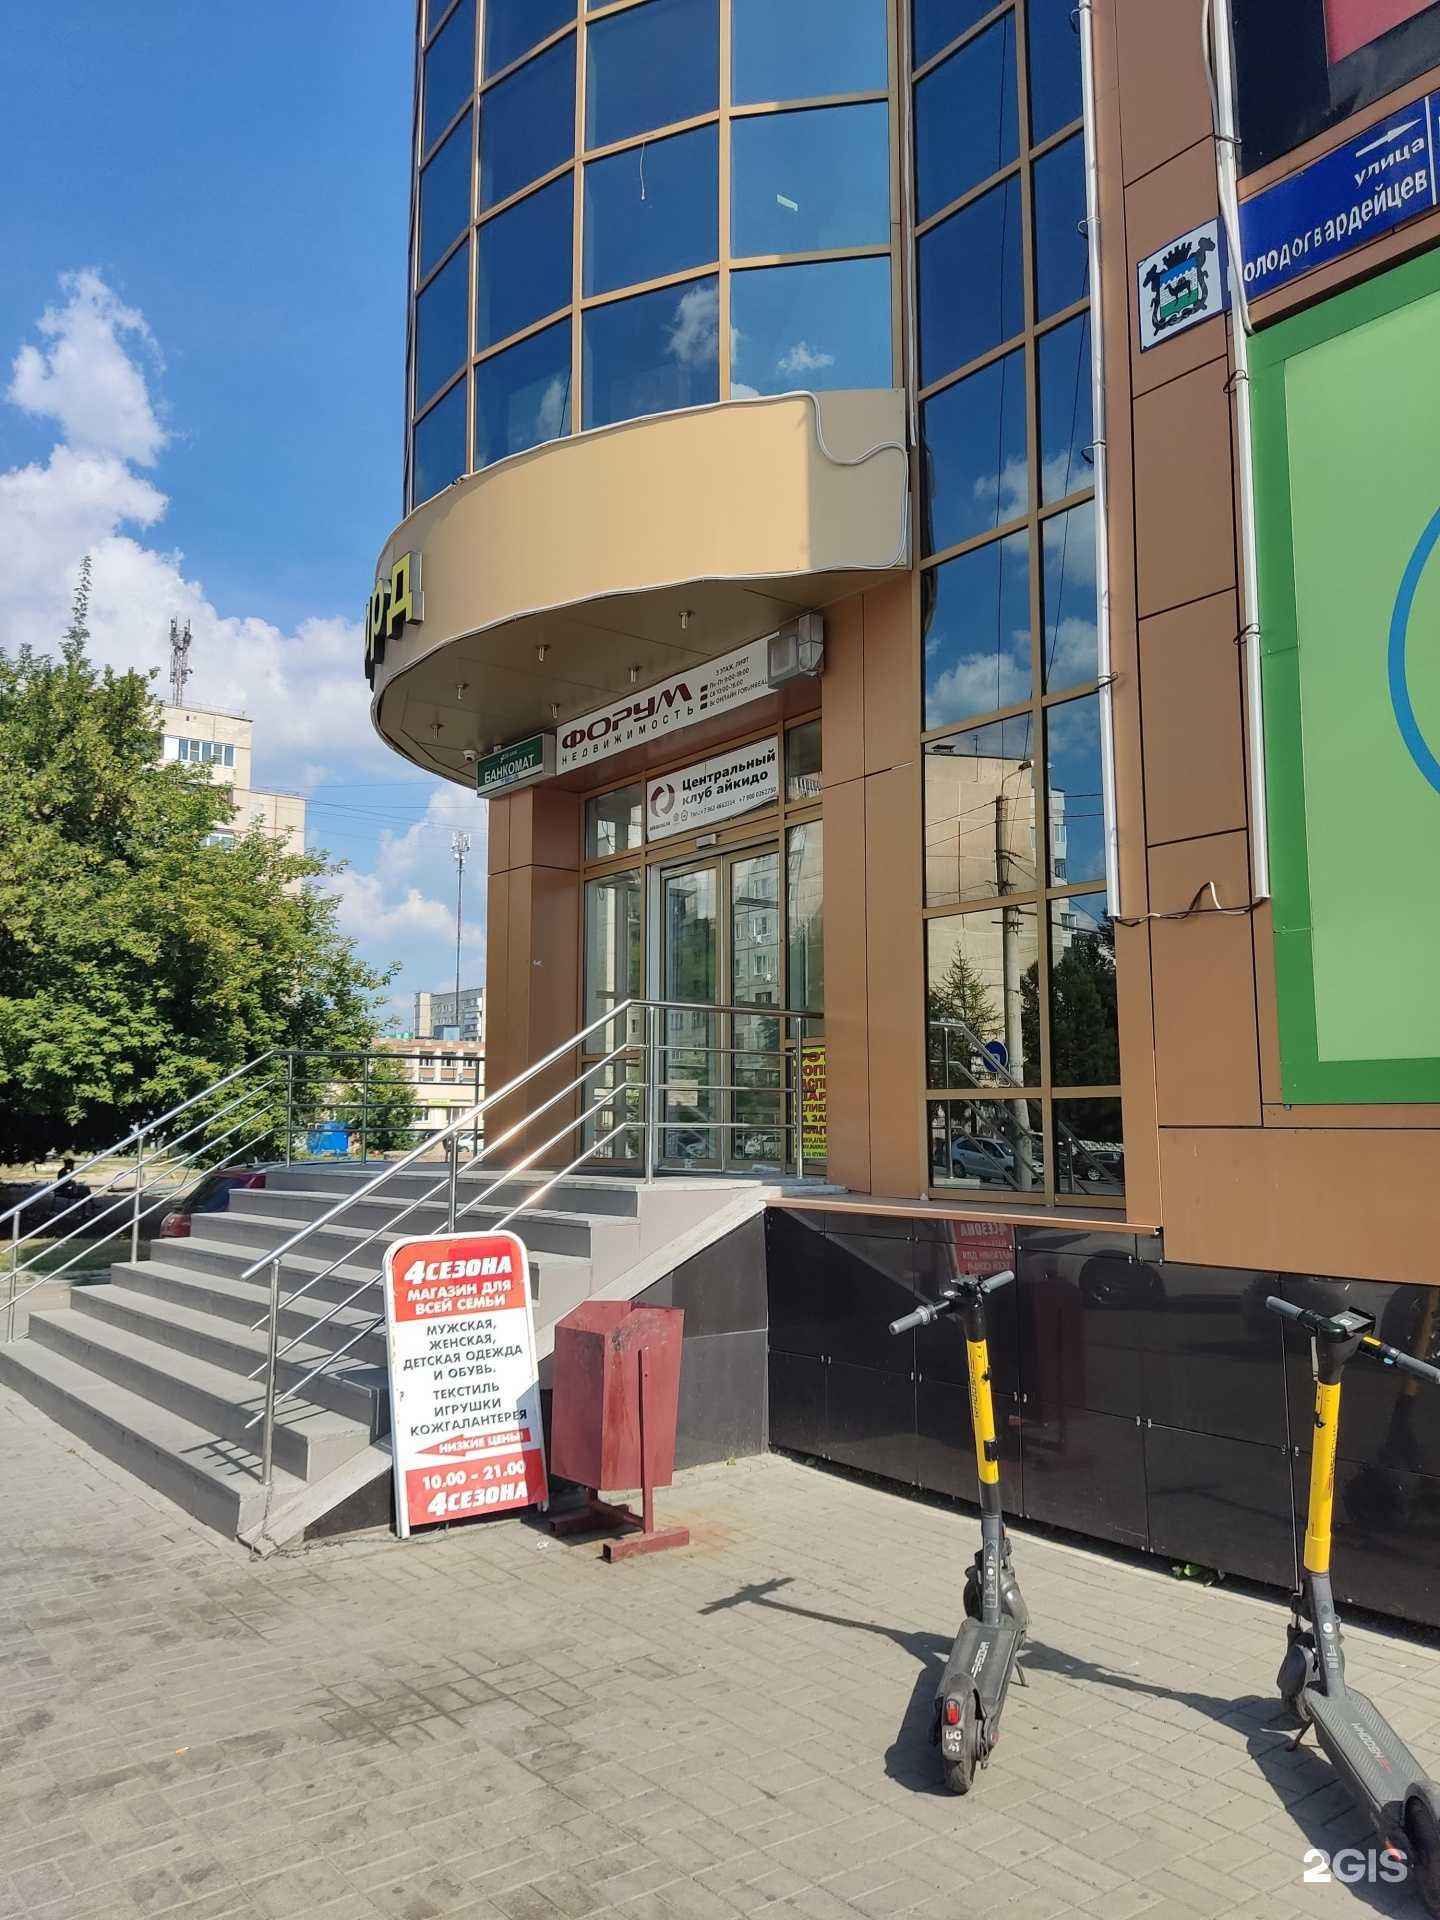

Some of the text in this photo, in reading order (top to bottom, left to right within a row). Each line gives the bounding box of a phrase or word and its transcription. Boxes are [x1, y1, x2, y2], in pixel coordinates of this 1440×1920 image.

[1353, 137, 1425, 187] улица
[1243, 169, 1428, 282] олодогвардейцев
[561, 682, 693, 749] ФОРУМ
[561, 705, 694, 765] НЕДВИЖИМОСТЬ
[484, 754, 535, 784] БАНКОМАТ
[682, 748, 776, 792] Центральный
[682, 770, 768, 806] клуб айкидо
[407, 1280, 512, 1302] МАГАЗИН ДЛЯ
[416, 1296, 506, 1315] ВСЕЙ СЕМЬИ
[426, 1319, 496, 1336] МУЖСКАЯ,
[429, 1334, 496, 1350] ЖЕНСКАЯ,
[403, 1345, 523, 1371] ДЕТСКАЯ ОДЕЖДА
[434, 1371, 443, 1380] И
[433, 1382, 500, 1400] ТЕКСТИЛЬ
[434, 1398, 502, 1417] ИГРУШКИ
[410, 1409, 528, 1437] КОЖГАЛАНТЕРЕЯ
[439, 1437, 486, 1454] НИЗКИЕ
[422, 1470, 466, 1490] 10.00
[482, 1460, 526, 1480] 21.00
